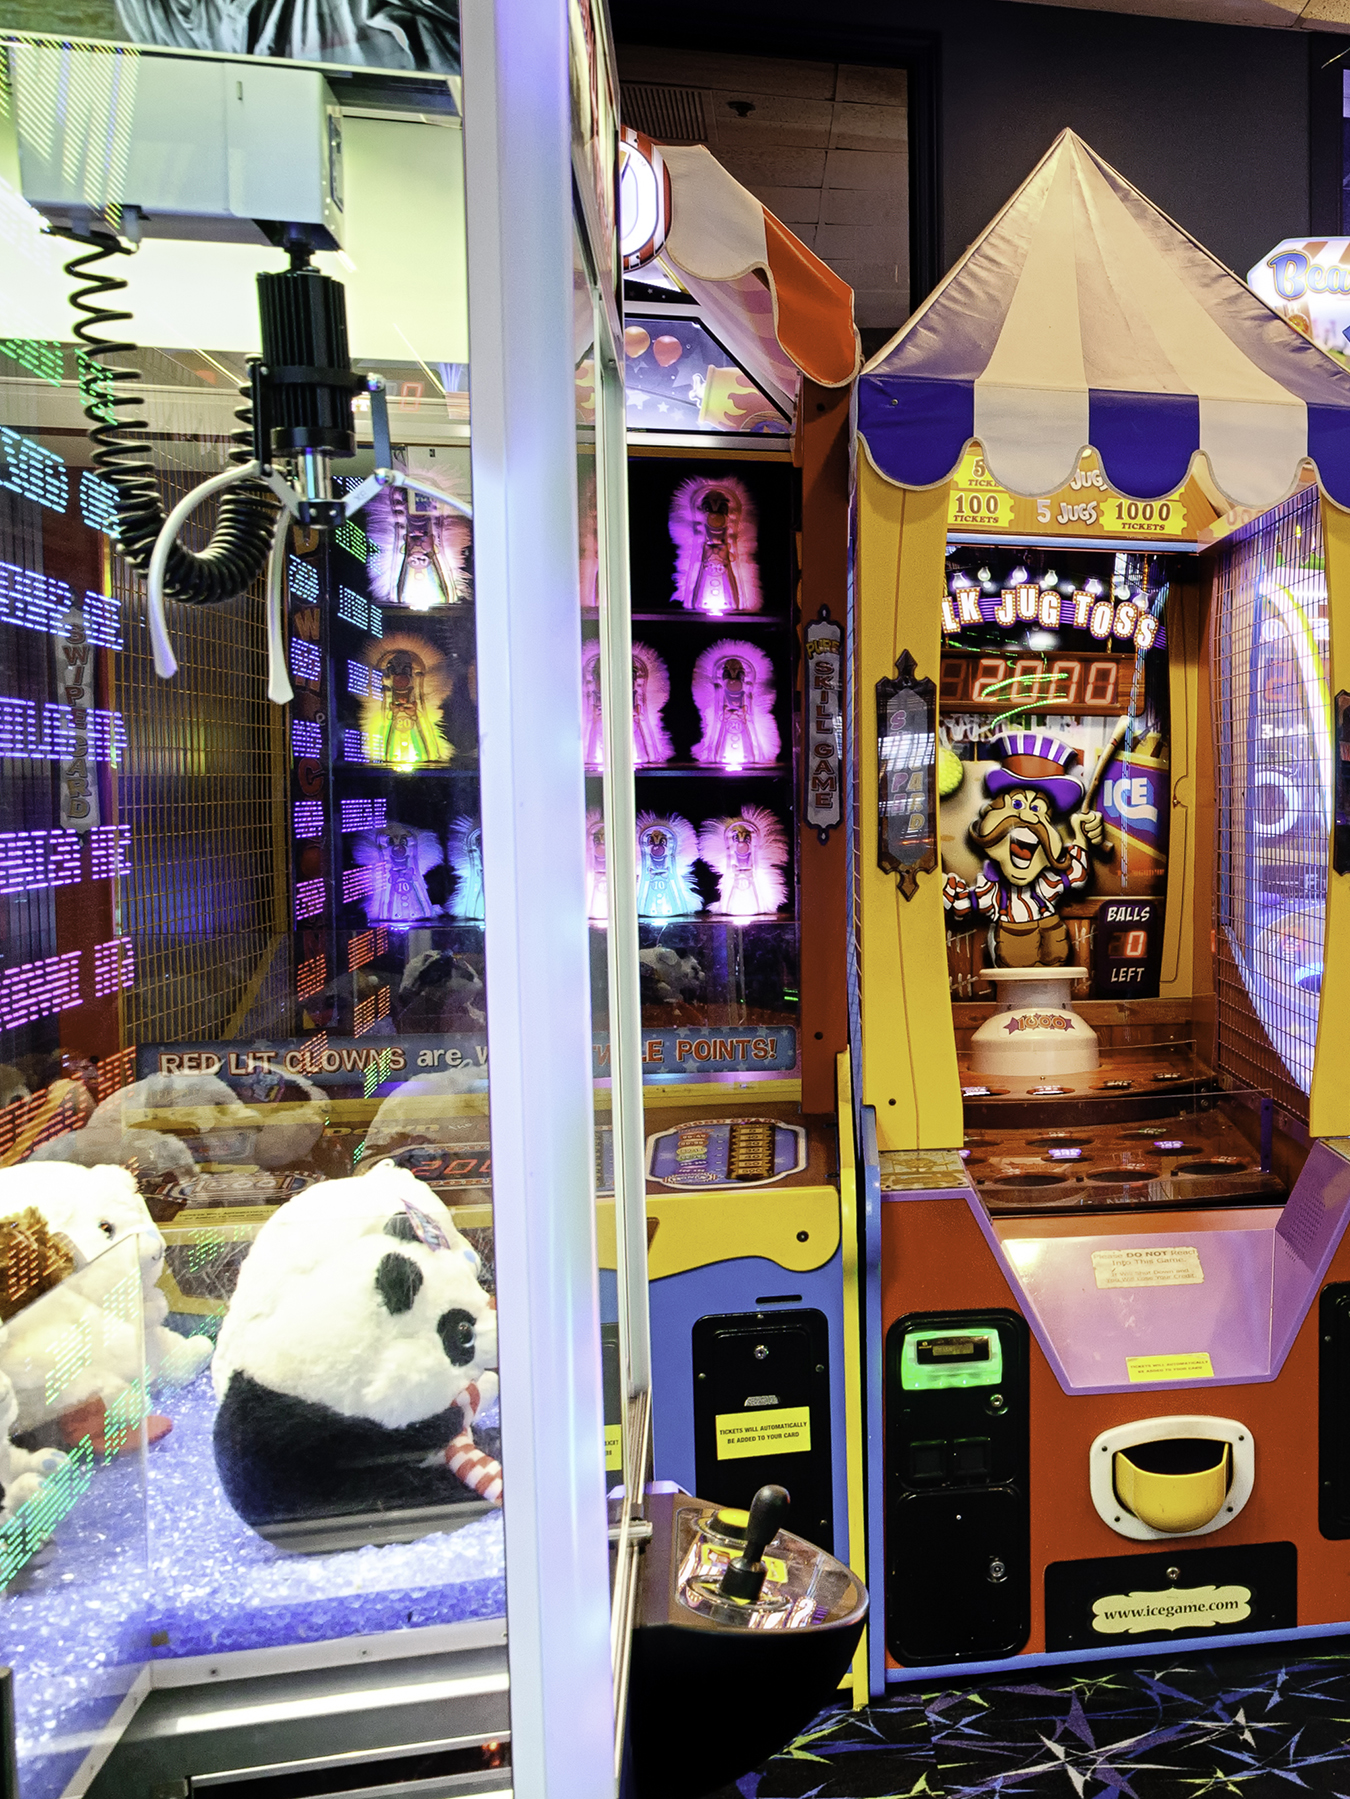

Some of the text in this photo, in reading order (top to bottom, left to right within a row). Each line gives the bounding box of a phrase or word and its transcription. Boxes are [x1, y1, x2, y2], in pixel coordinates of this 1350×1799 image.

[955, 494, 1171, 525] 100 5 JUGS 1000
[953, 515, 1166, 531] TICKETS TICKETS
[995, 584, 1061, 630] JUG
[1073, 592, 1158, 650] TOSS
[805, 638, 840, 659] PURE
[64, 623, 89, 730] SWIPE
[814, 661, 835, 733] SKILL
[811, 743, 837, 808] GAME
[1103, 776, 1158, 824] ICE
[1107, 906, 1150, 923] BALLS
[1126, 931, 1147, 957] 0
[1111, 967, 1145, 984] LEFT
[1018, 1014, 1068, 1032] 1000
[159, 1052, 223, 1077] RED
[228, 1051, 276, 1075] LIT
[285, 1047, 406, 1073] CLOWNS
[417, 1045, 462, 1067] are
[676, 1039, 778, 1062] POINTS!
[1156, 1256, 1187, 1264] Game.
[720, 1427, 743, 1436] TICKETS
[760, 1421, 808, 1432] AUTOMATICALLY
[736, 1435, 757, 1444] ADDED
[783, 1431, 800, 1439] CARD
[1103, 1597, 1240, 1622] www.icegame.com
